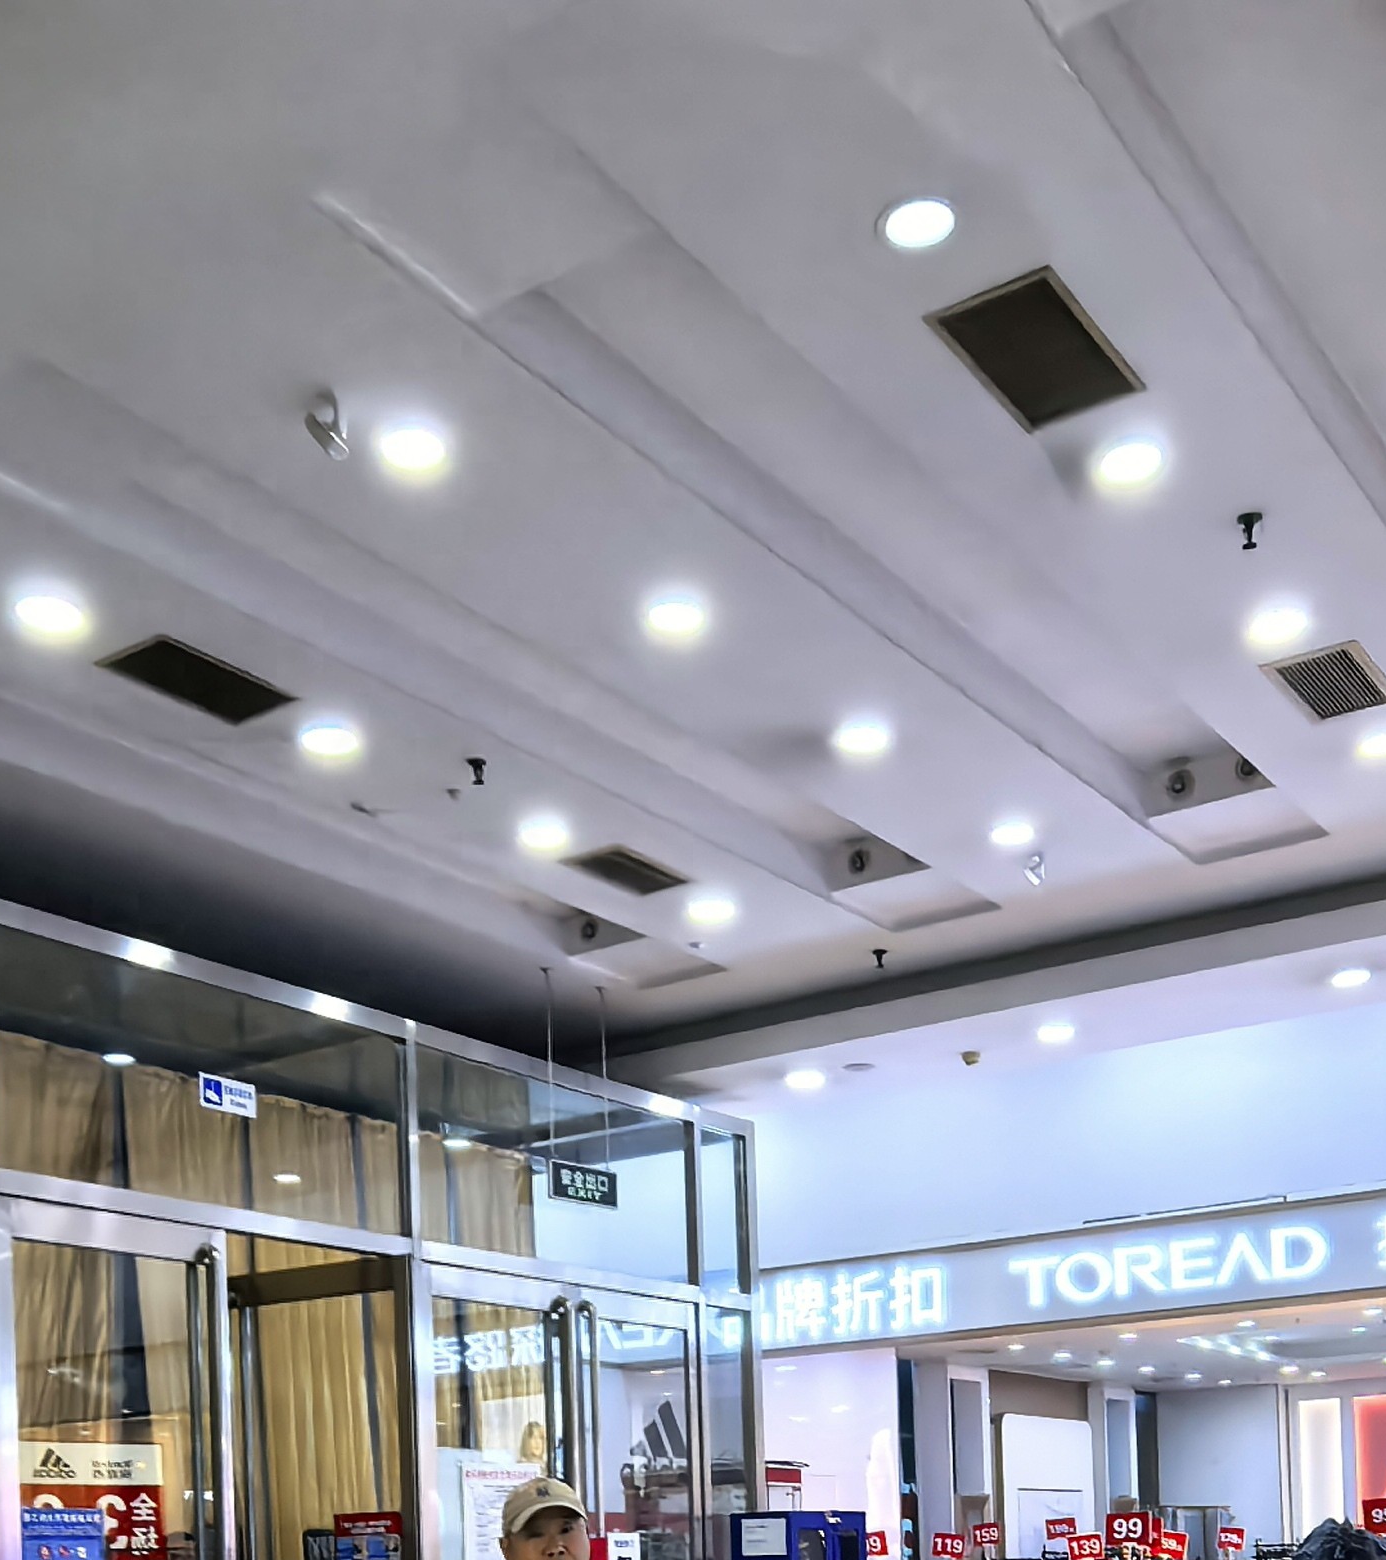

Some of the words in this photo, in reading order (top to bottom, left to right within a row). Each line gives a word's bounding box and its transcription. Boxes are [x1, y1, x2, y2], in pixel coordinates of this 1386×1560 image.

[559, 1168, 610, 1192] 安全出口
[567, 1186, 602, 1201] EXIT
[1007, 1223, 1329, 1310] TOREAD
[973, 1527, 1000, 1543] 159
[1112, 1517, 1144, 1540] 99
[934, 1537, 964, 1554] 119
[1069, 1538, 1101, 1557] 139
